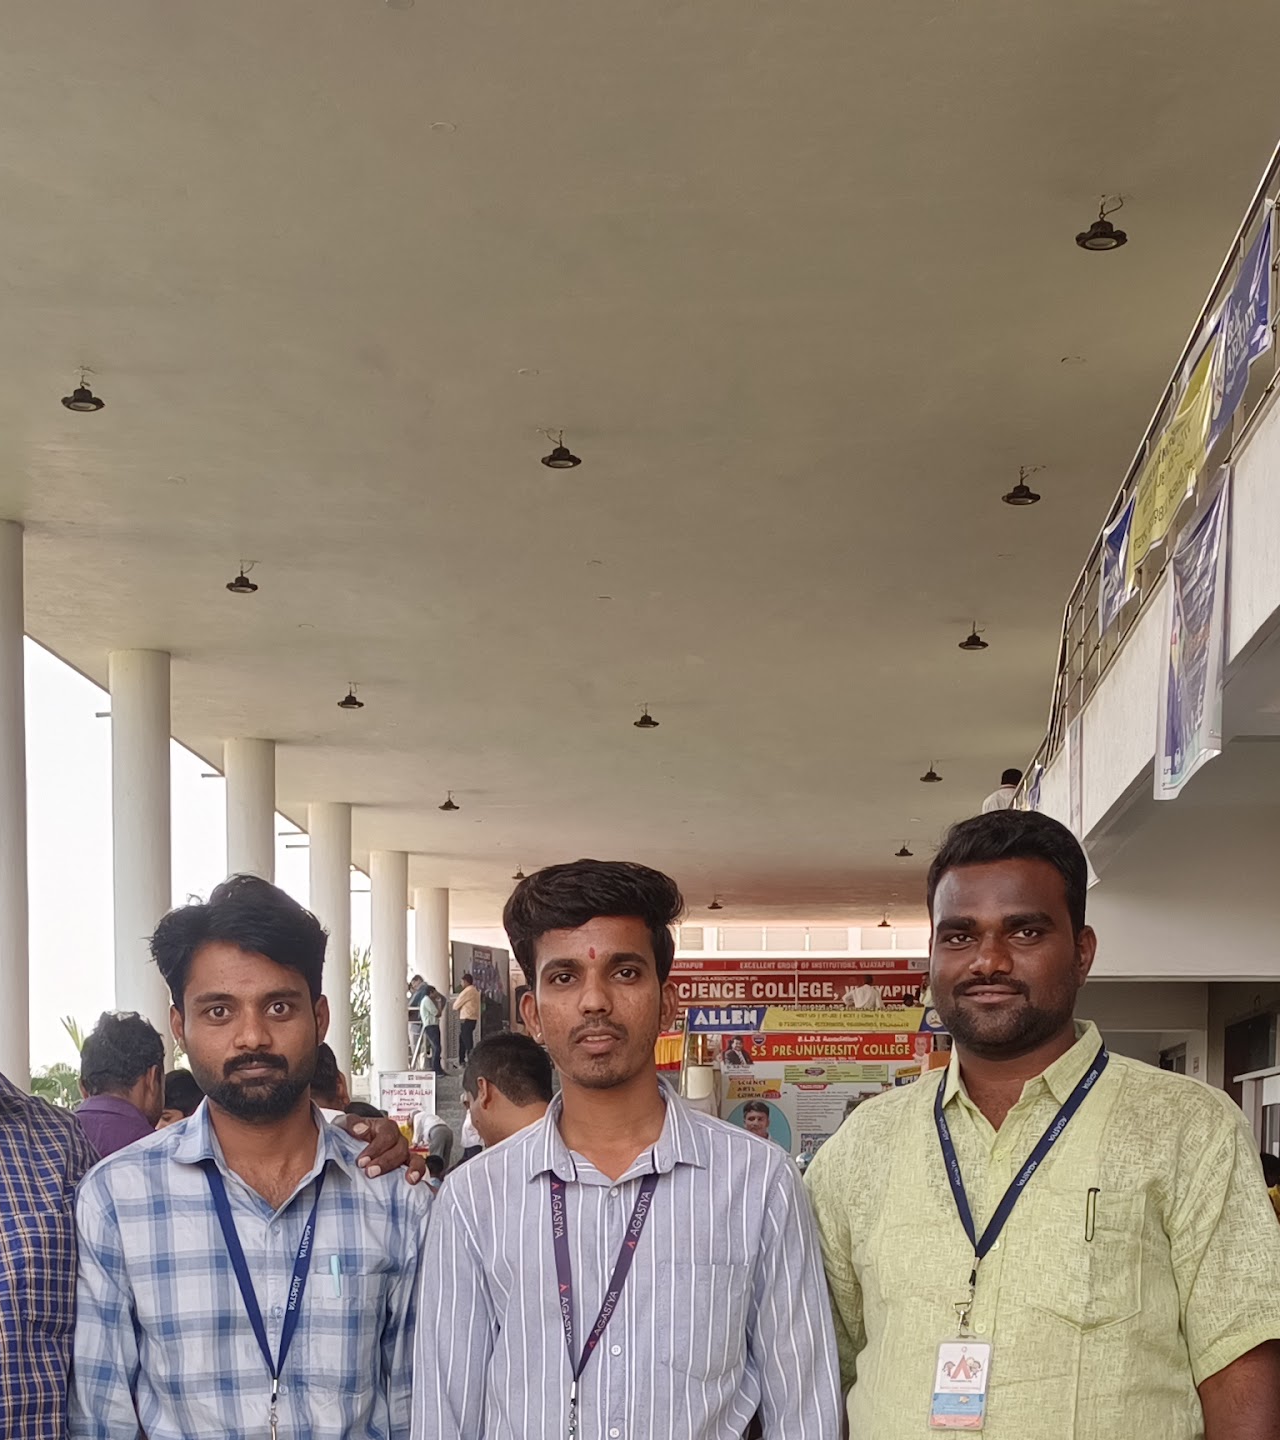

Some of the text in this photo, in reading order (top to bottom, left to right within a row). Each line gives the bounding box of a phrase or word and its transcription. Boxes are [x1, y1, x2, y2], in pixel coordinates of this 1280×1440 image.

[859, 961, 895, 969] VIJAYAPUR
[677, 982, 746, 999] CIENCE
[752, 982, 839, 1000] COLLEGE,
[693, 1009, 757, 1026] ALLEN
[772, 1044, 861, 1057] PRE-UNIVERSITY
[862, 1044, 911, 1056] COLLEGE
[552, 1192, 564, 1239] AGASTYA
[628, 1190, 653, 1238] AGASTYA
[561, 1295, 573, 1346] AGASTYA
[592, 1289, 619, 1338] AGASTYA
